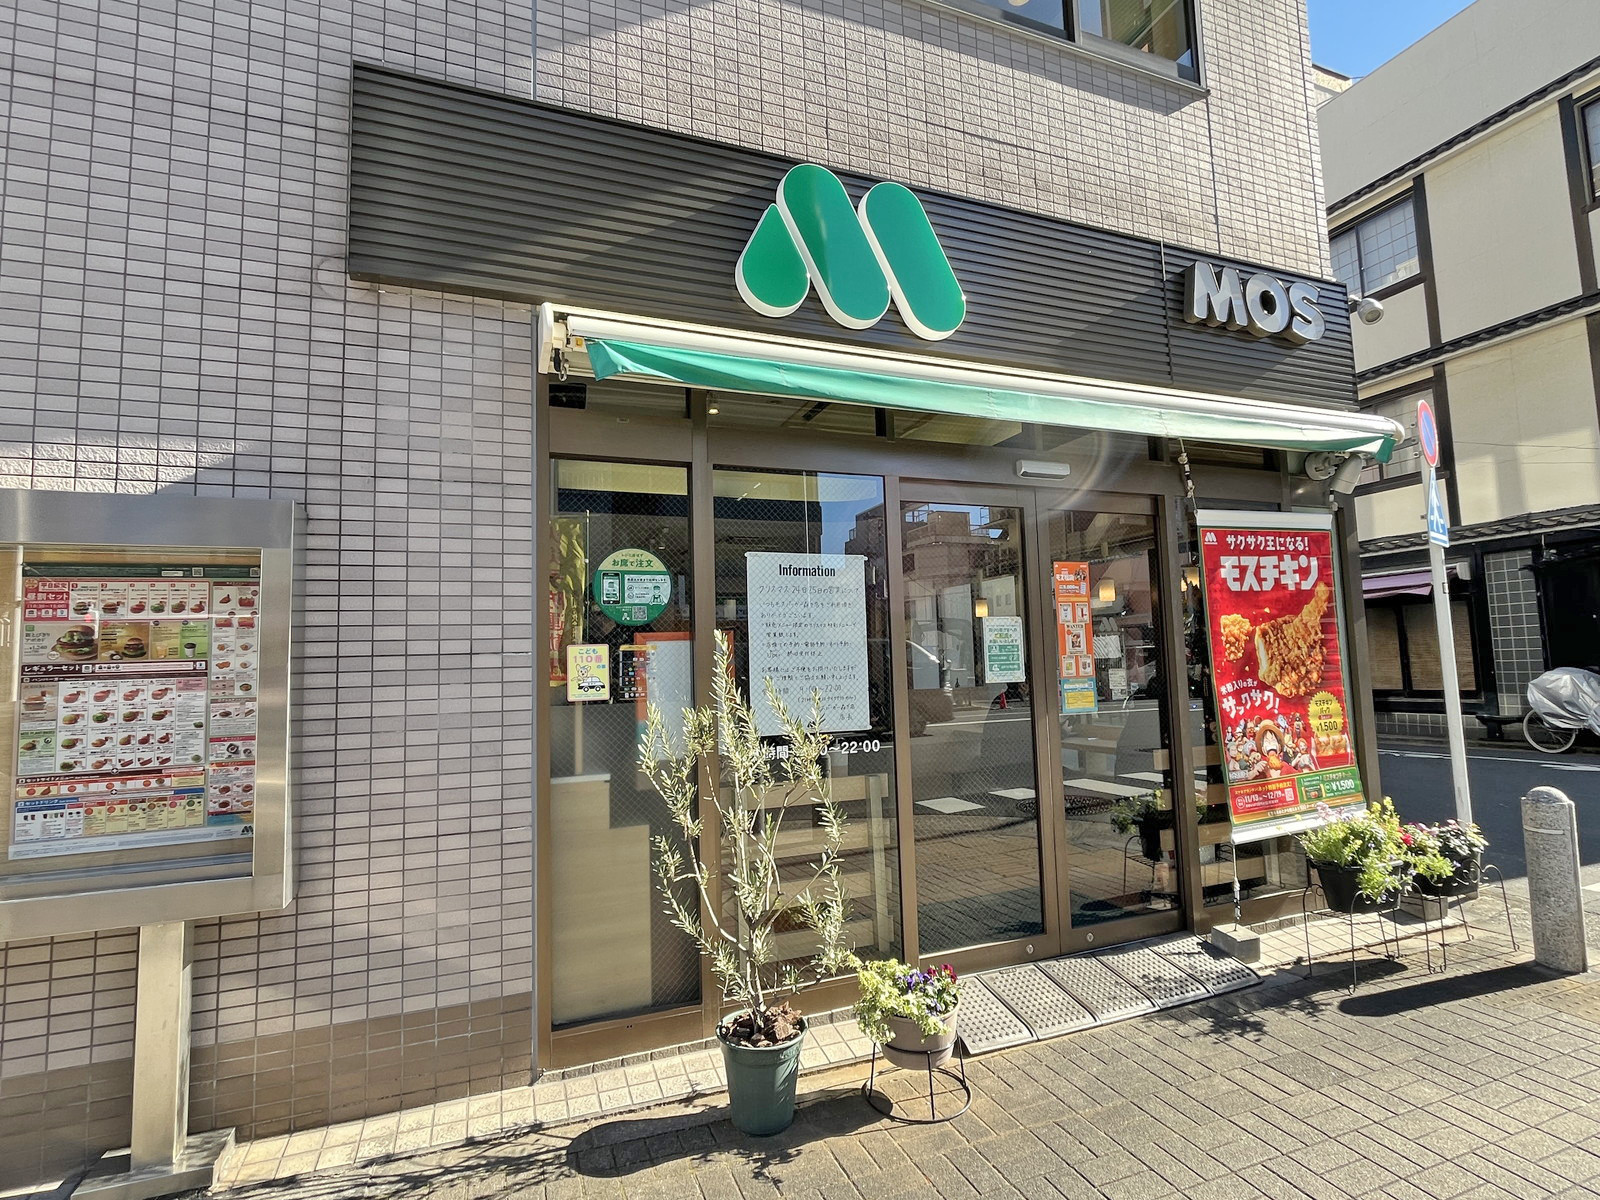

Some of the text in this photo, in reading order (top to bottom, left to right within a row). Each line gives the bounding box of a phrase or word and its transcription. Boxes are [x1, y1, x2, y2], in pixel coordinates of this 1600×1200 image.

[1184, 260, 1326, 344] MOS
[1226, 534, 1309, 551] サクサク王になる!
[611, 559, 654, 568] お席で注文
[779, 564, 836, 577] Information
[1220, 554, 1318, 591] モスチキン
[24, 664, 80, 672] レギュラーセット
[1221, 688, 1280, 719] サックサク!
